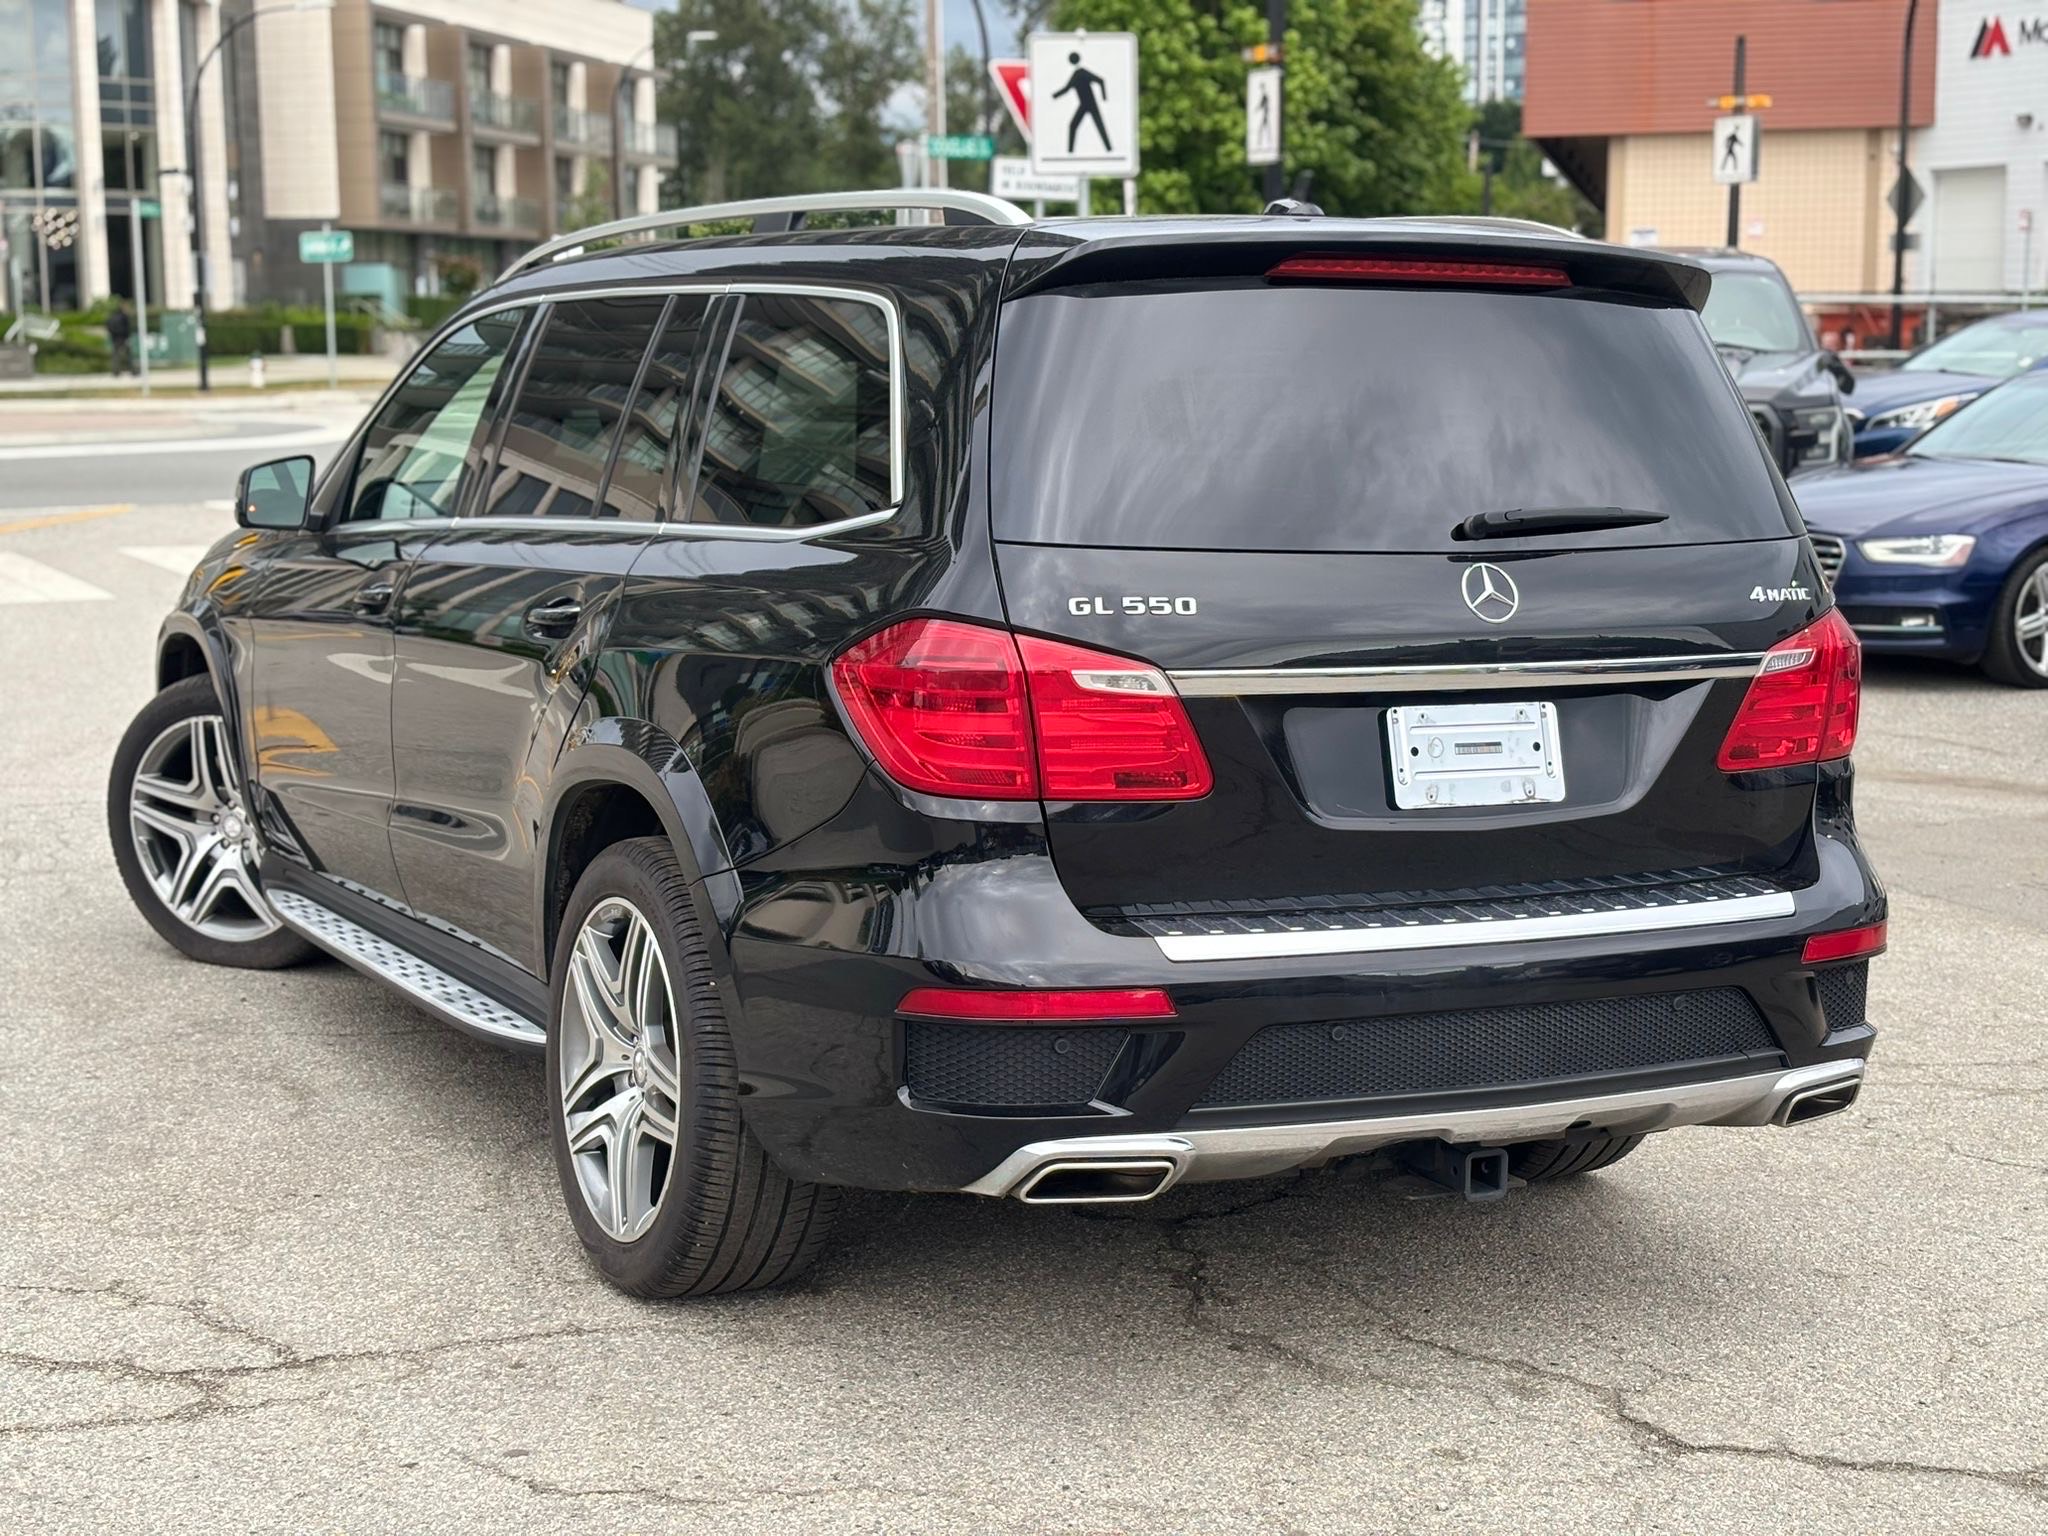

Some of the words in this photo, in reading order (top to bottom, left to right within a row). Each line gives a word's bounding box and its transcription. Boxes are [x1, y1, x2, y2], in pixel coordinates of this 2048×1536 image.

[1749, 585, 1812, 602] 4MATIC
[1068, 597, 1114, 616] GL
[1122, 597, 1197, 616] 550
